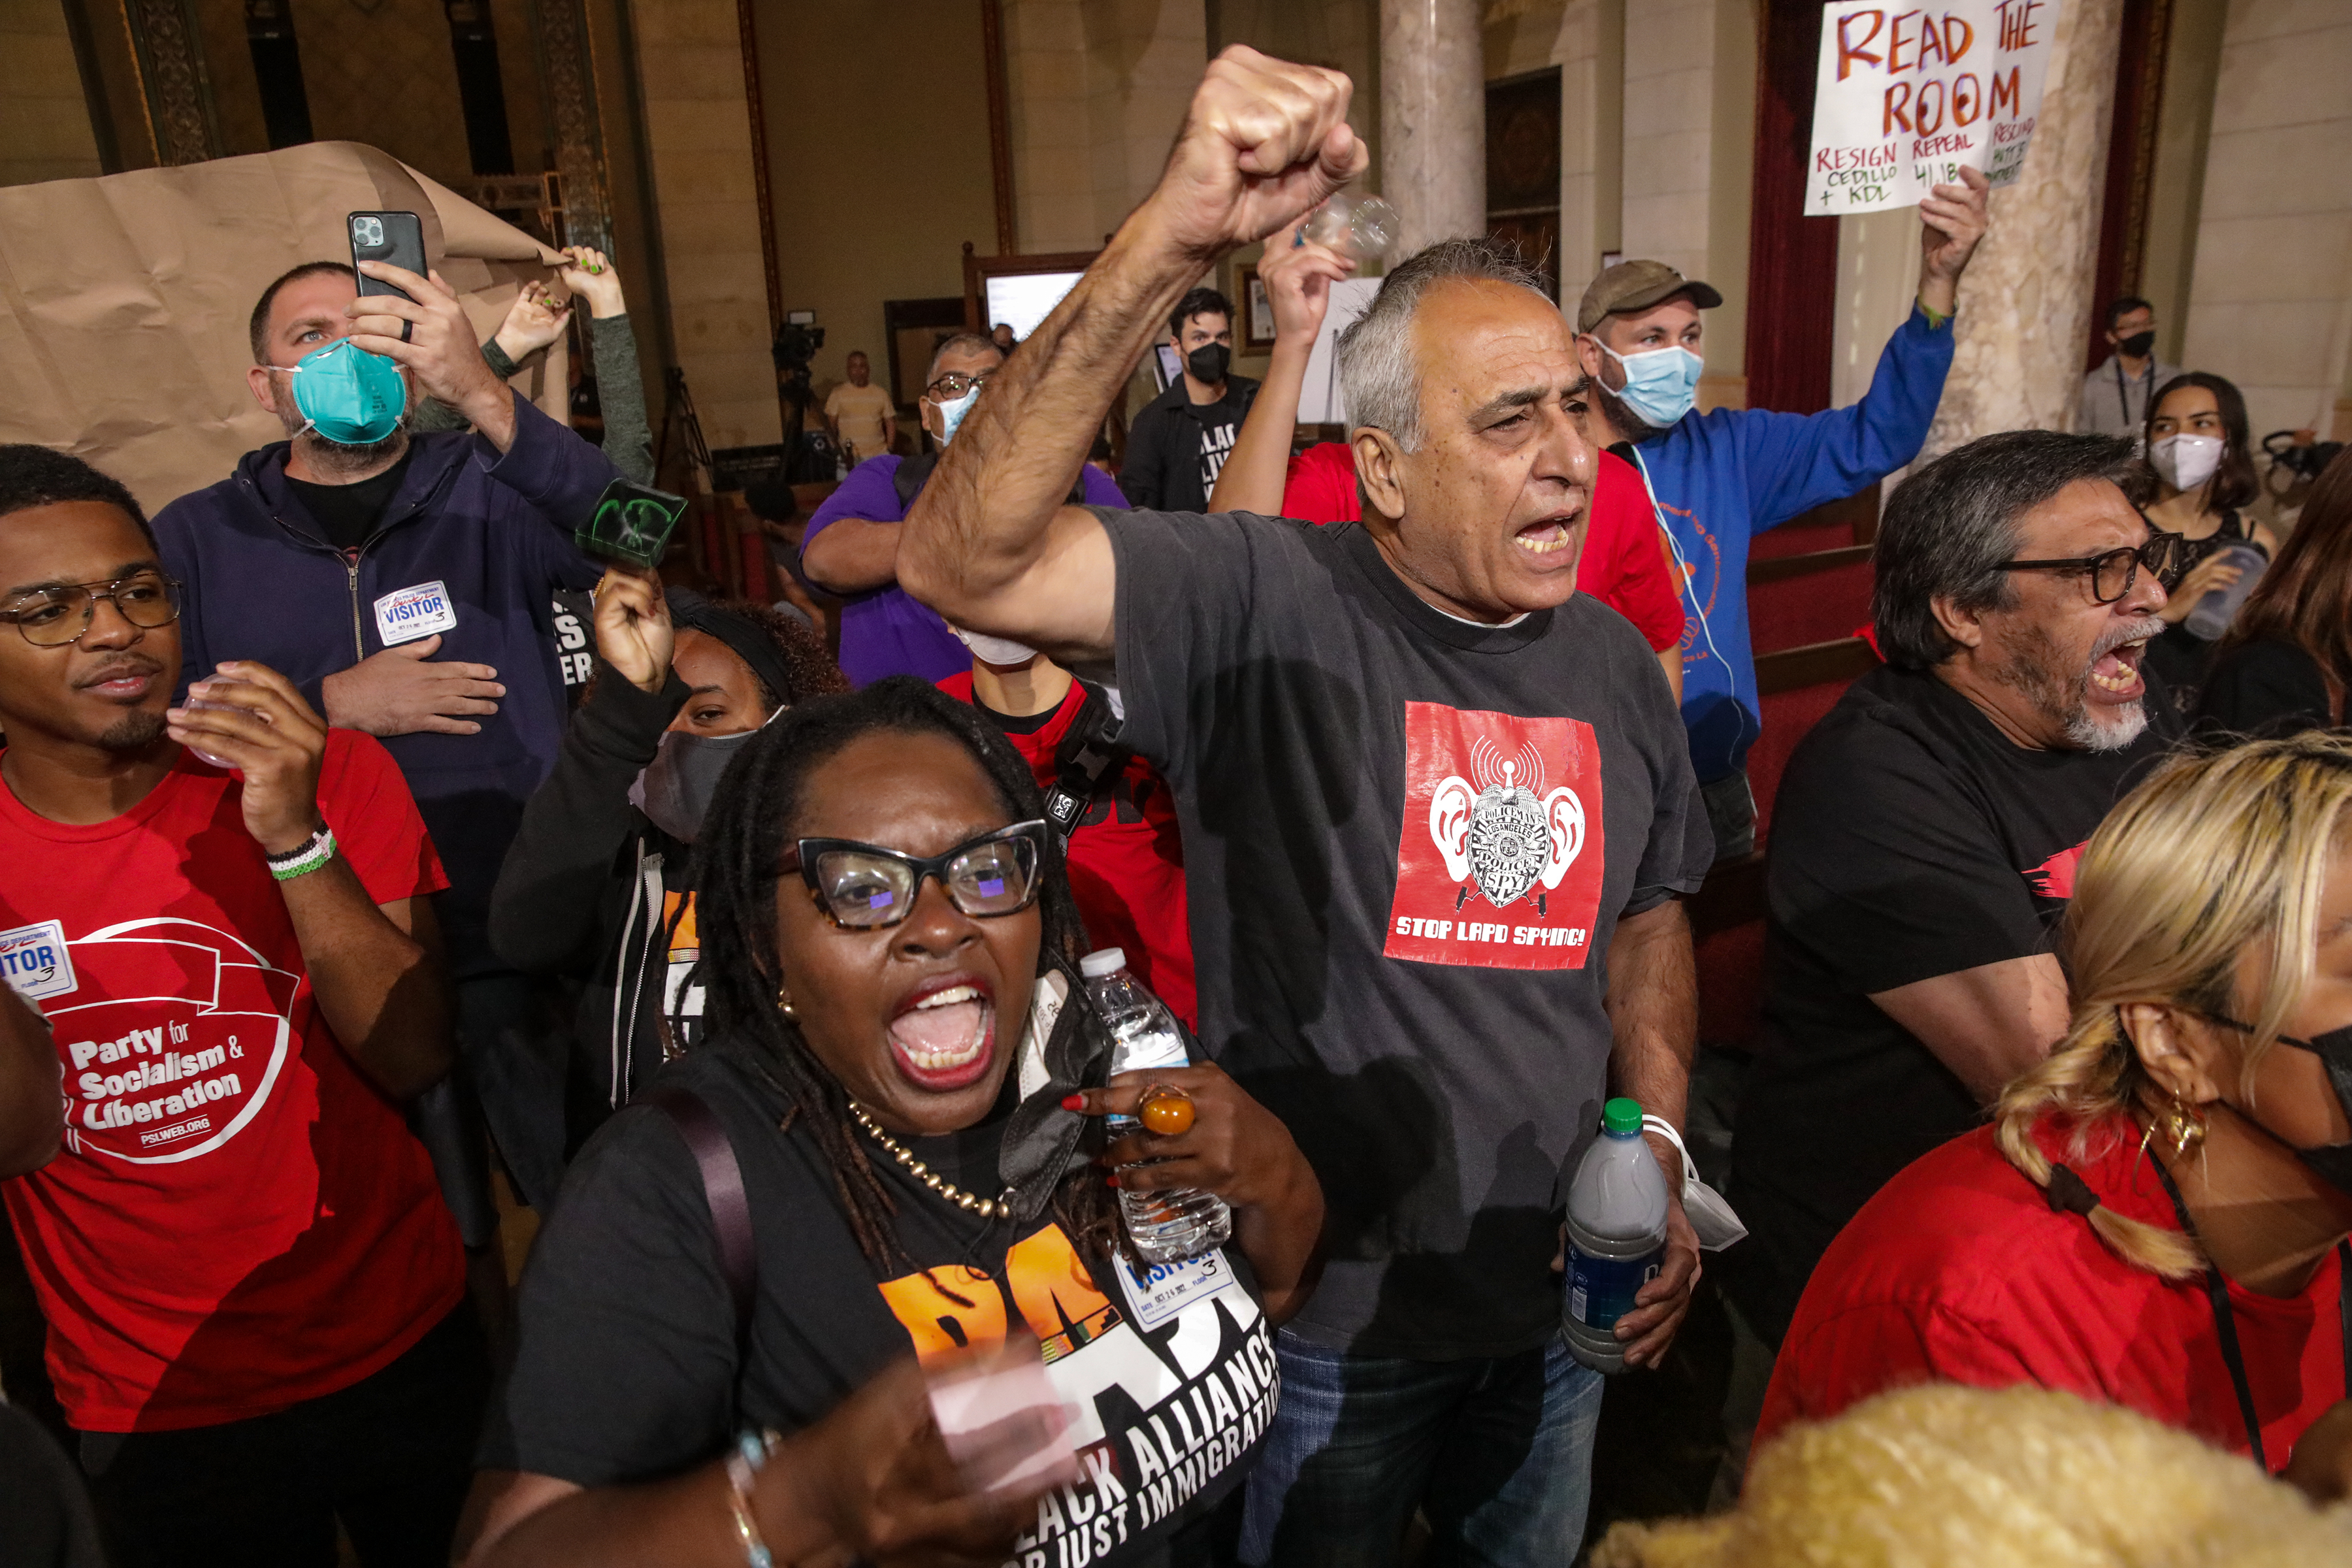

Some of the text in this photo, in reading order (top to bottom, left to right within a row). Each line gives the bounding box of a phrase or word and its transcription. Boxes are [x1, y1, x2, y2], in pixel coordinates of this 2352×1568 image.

[1837, 0, 2045, 82] READ THE
[1883, 65, 2022, 139] ROOM
[1816, 142, 1897, 172] RESIGN
[1912, 133, 1974, 160] REPEAL
[1827, 165, 1897, 187] CEDILLO
[1820, 184, 1892, 206] + KDL
[384, 596, 444, 623] VISITOR
[434, 612, 444, 622] 3
[1485, 807, 1536, 824] POLICEMAN
[1488, 823, 1532, 838] LOS ANGELES
[1482, 853, 1531, 871] POLICE
[1487, 874, 1522, 888] SPY
[1396, 916, 1586, 946] STOP LAPD SPYING!
[0, 945, 56, 977] ITOR
[33, 966, 55, 982] 3
[69, 1020, 189, 1070] Party for
[78, 1035, 244, 1100] Socialism &
[83, 1073, 242, 1130] Liberation
[140, 1118, 210, 1145] PSLWEB.ORG
[1155, 1294, 1166, 1303] OCT
[1201, 1259, 1217, 1276] 3
[1014, 1316, 1276, 1554] LACK ALLIANCE
